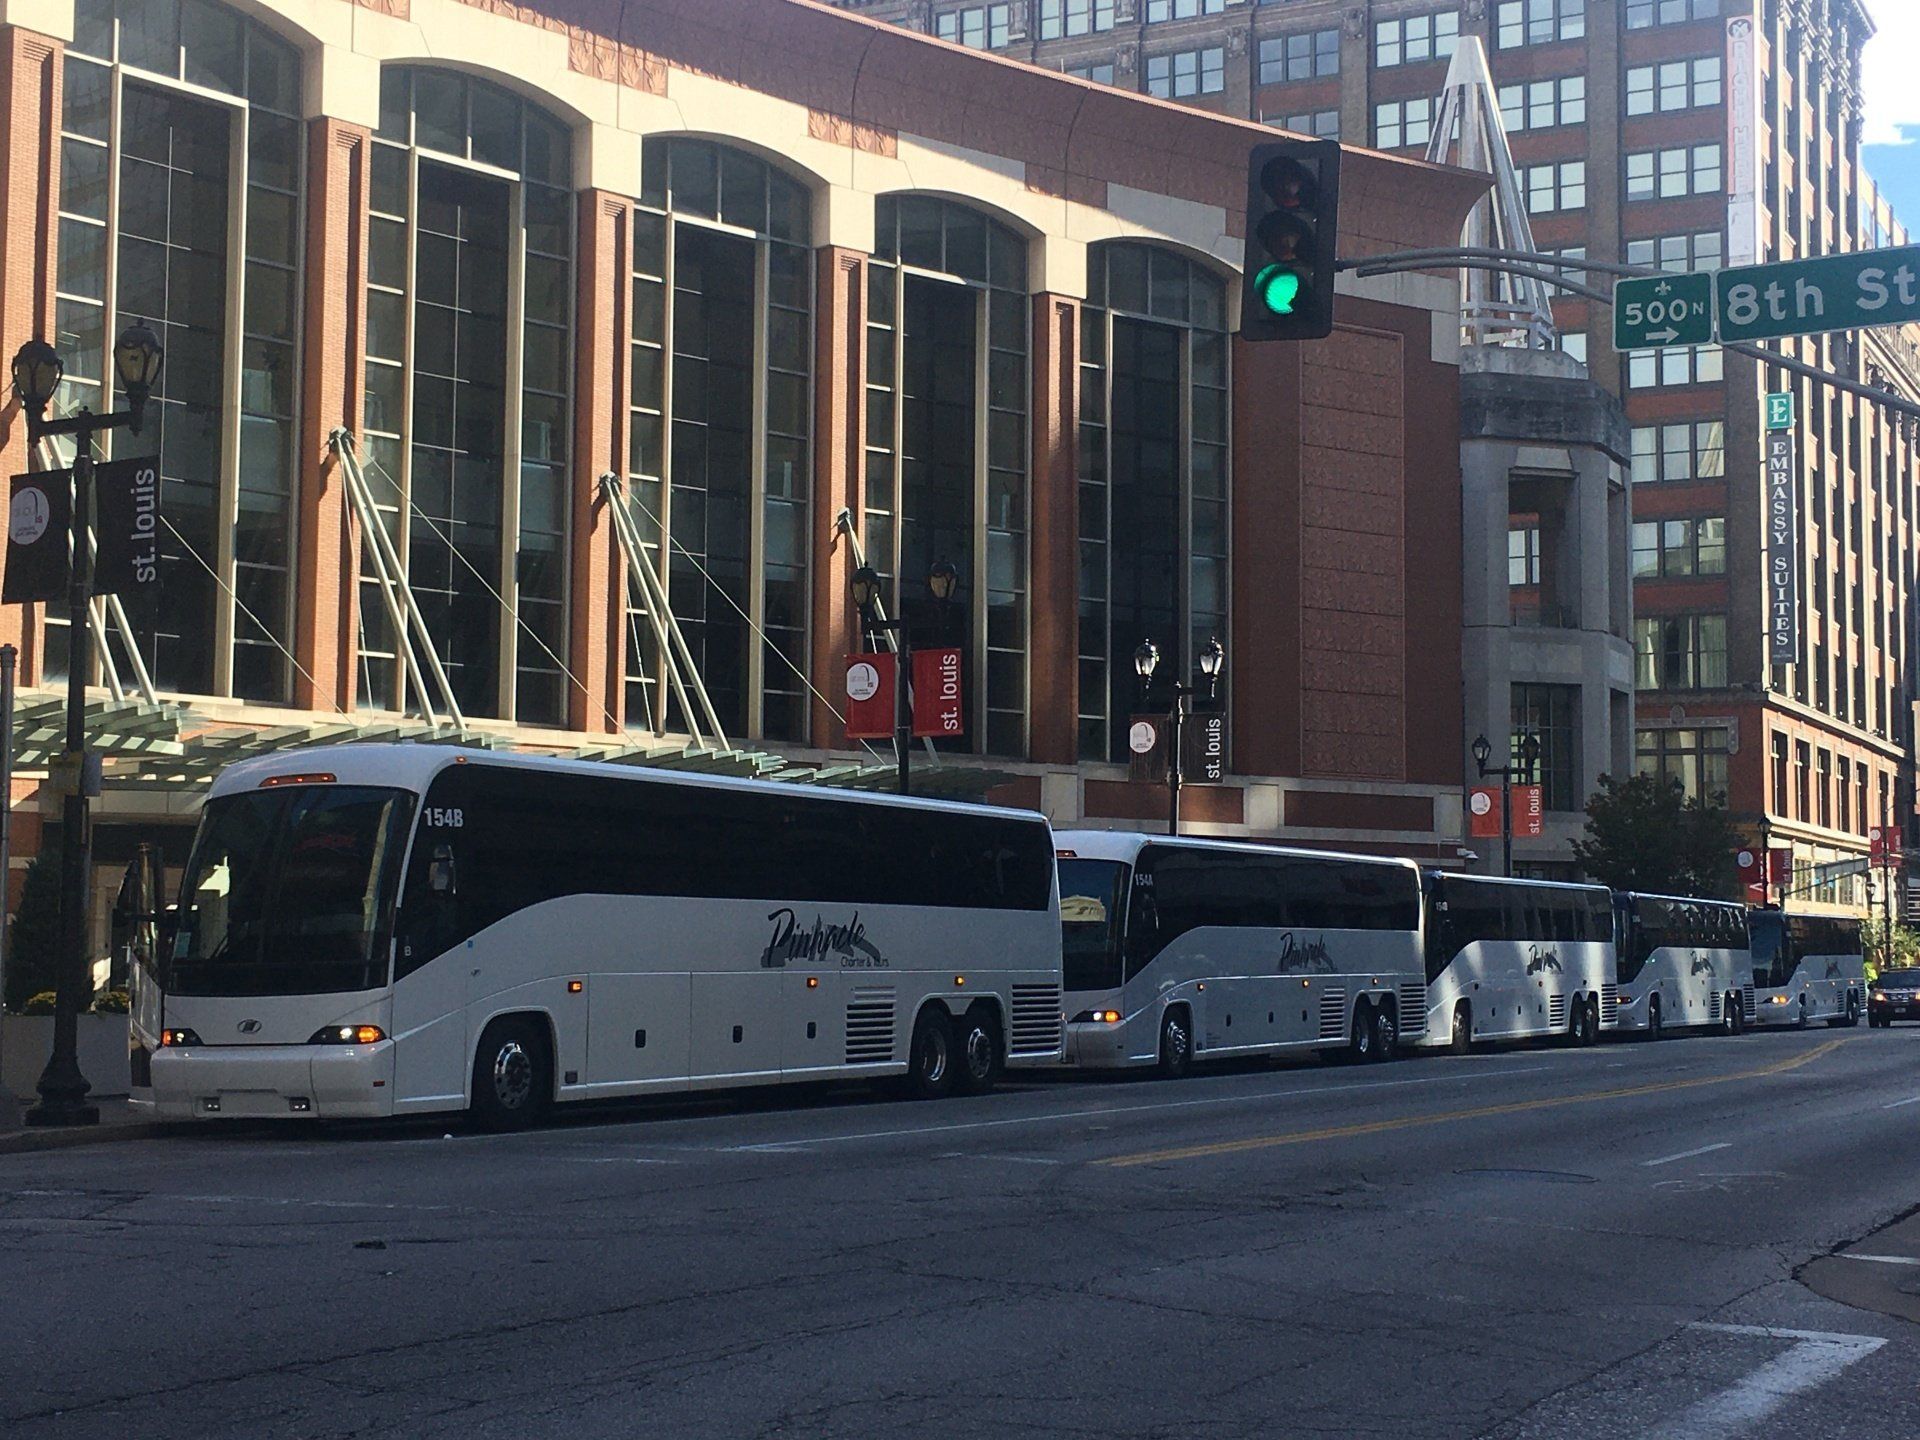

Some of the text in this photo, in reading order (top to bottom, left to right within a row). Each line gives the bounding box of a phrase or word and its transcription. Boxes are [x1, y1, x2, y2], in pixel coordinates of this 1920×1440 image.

[1726, 264, 1917, 326] 8th St
[1769, 441, 1789, 546] EMBASSY
[130, 468, 157, 584] st. louis
[1773, 556, 1791, 646] SUITES
[939, 654, 958, 731] st. louis
[1205, 718, 1221, 779] st. louis
[424, 807, 464, 828] 154B
[1527, 788, 1540, 834] st. louis
[1135, 873, 1154, 886] 154A
